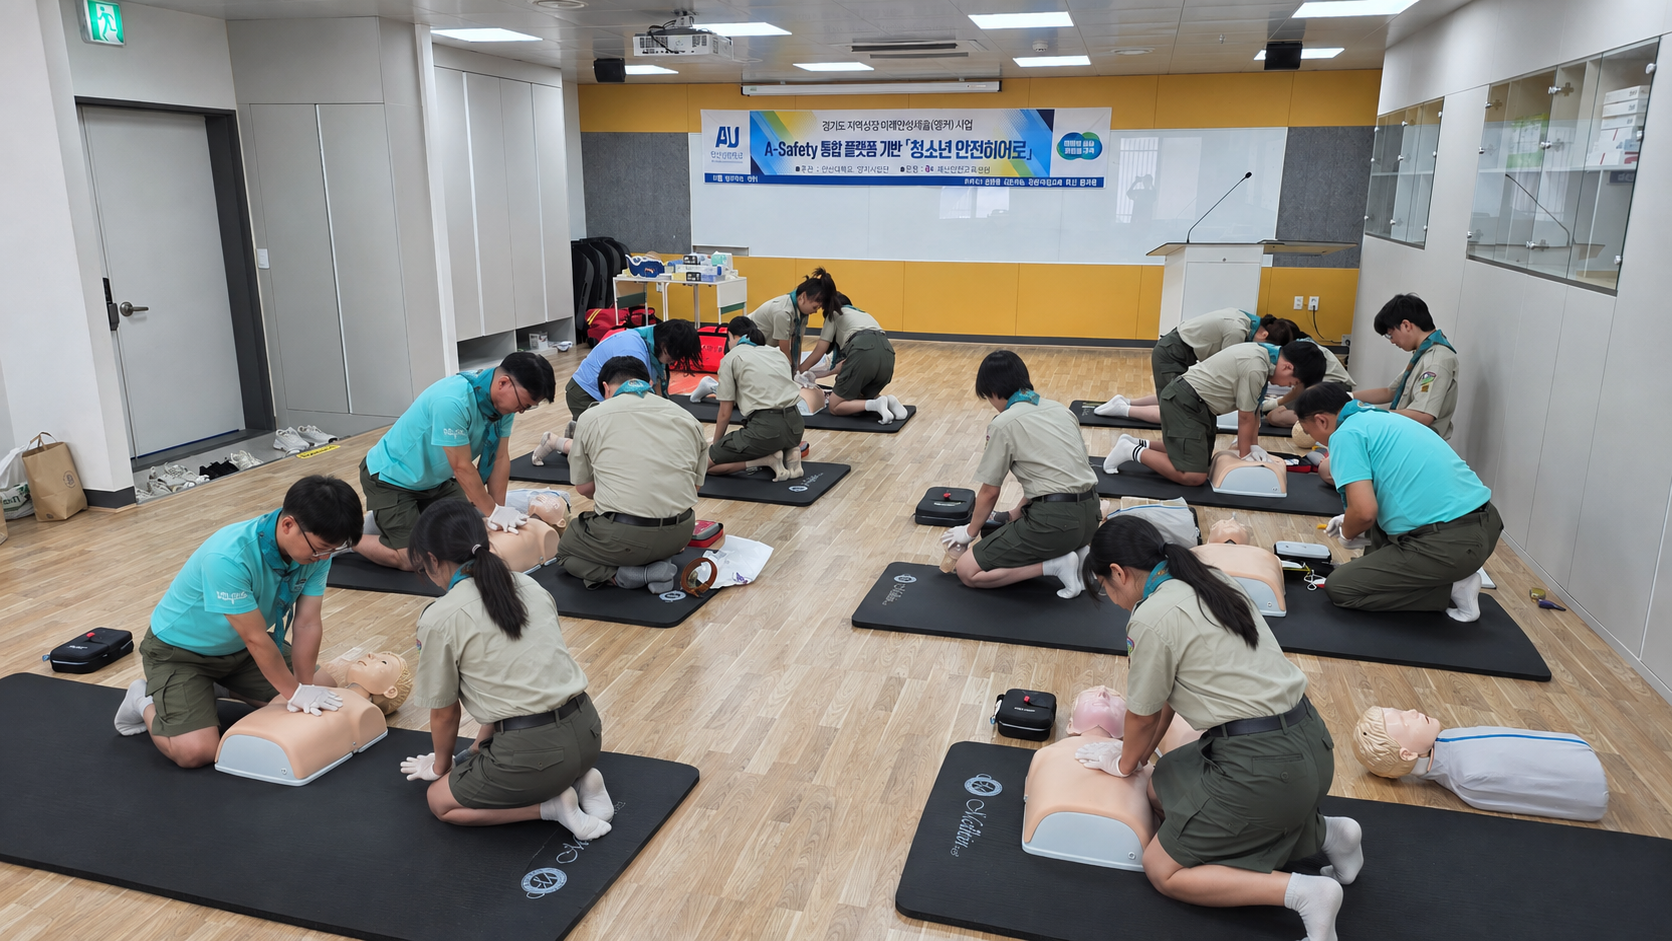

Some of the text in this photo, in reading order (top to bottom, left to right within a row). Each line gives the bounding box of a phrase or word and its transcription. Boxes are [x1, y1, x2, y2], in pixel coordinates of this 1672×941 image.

[822, 120, 847, 132] 경기도
[848, 120, 879, 132] 지역성장
[955, 119, 974, 131] 사업
[715, 126, 740, 148] AU
[764, 141, 818, 160] A-Safety
[821, 140, 843, 158] 통합
[845, 140, 877, 158] 플랫폼
[880, 140, 903, 158] 기반
